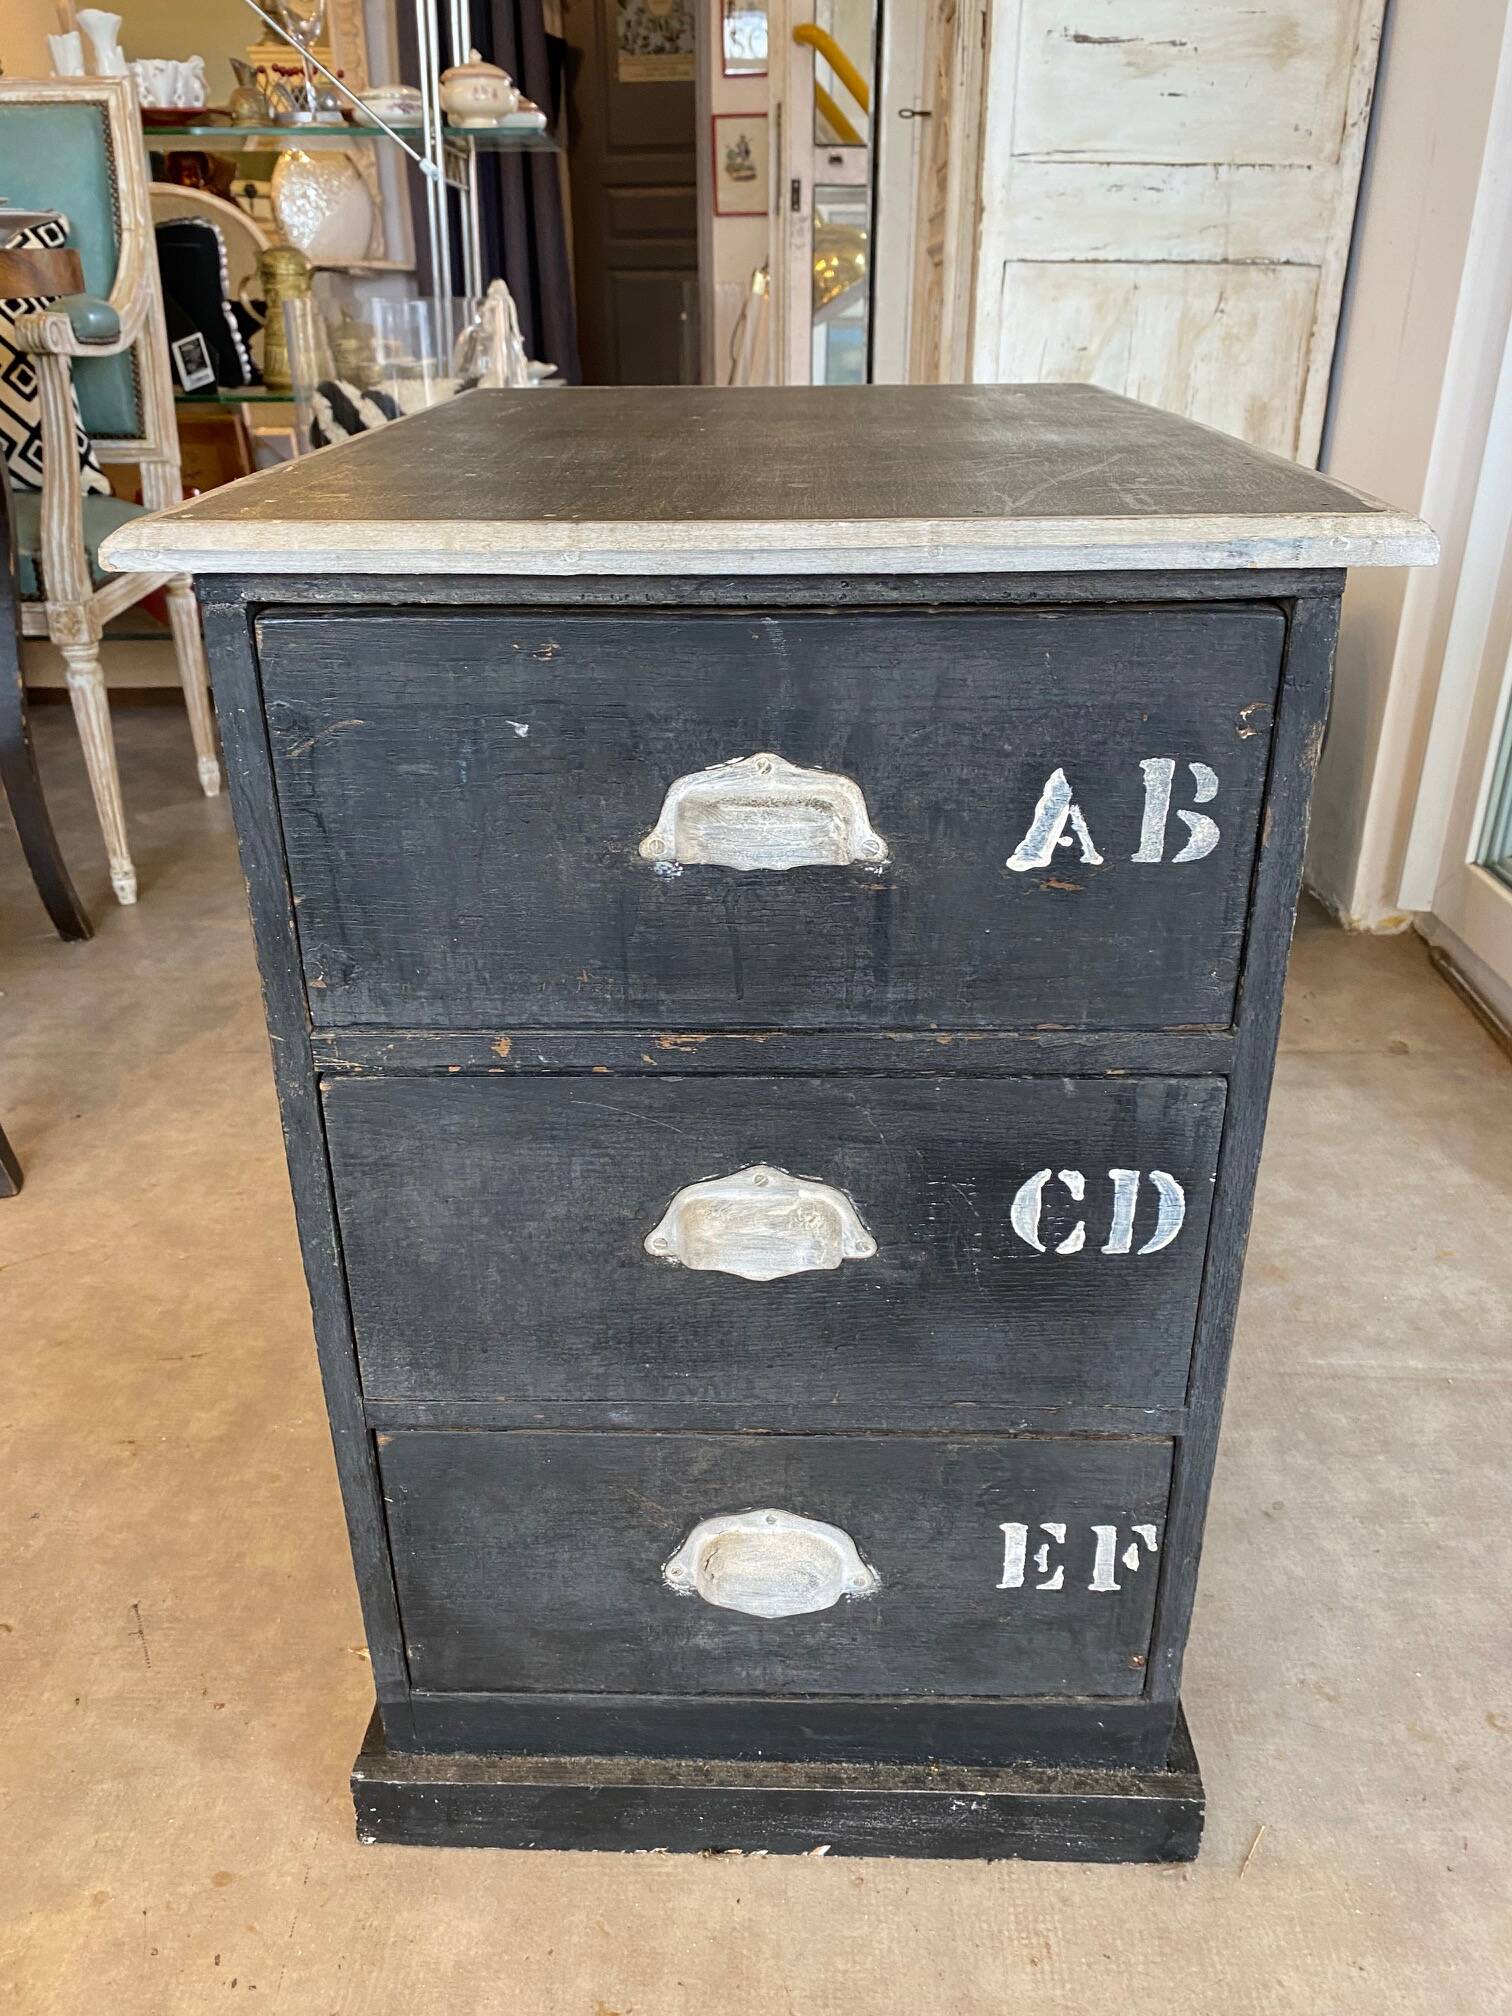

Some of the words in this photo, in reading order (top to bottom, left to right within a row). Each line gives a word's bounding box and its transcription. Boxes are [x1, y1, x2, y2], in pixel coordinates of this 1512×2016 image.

[1005, 757, 1221, 872] AB
[1010, 1168, 1186, 1256] CD
[996, 1522, 1159, 1593] EF
